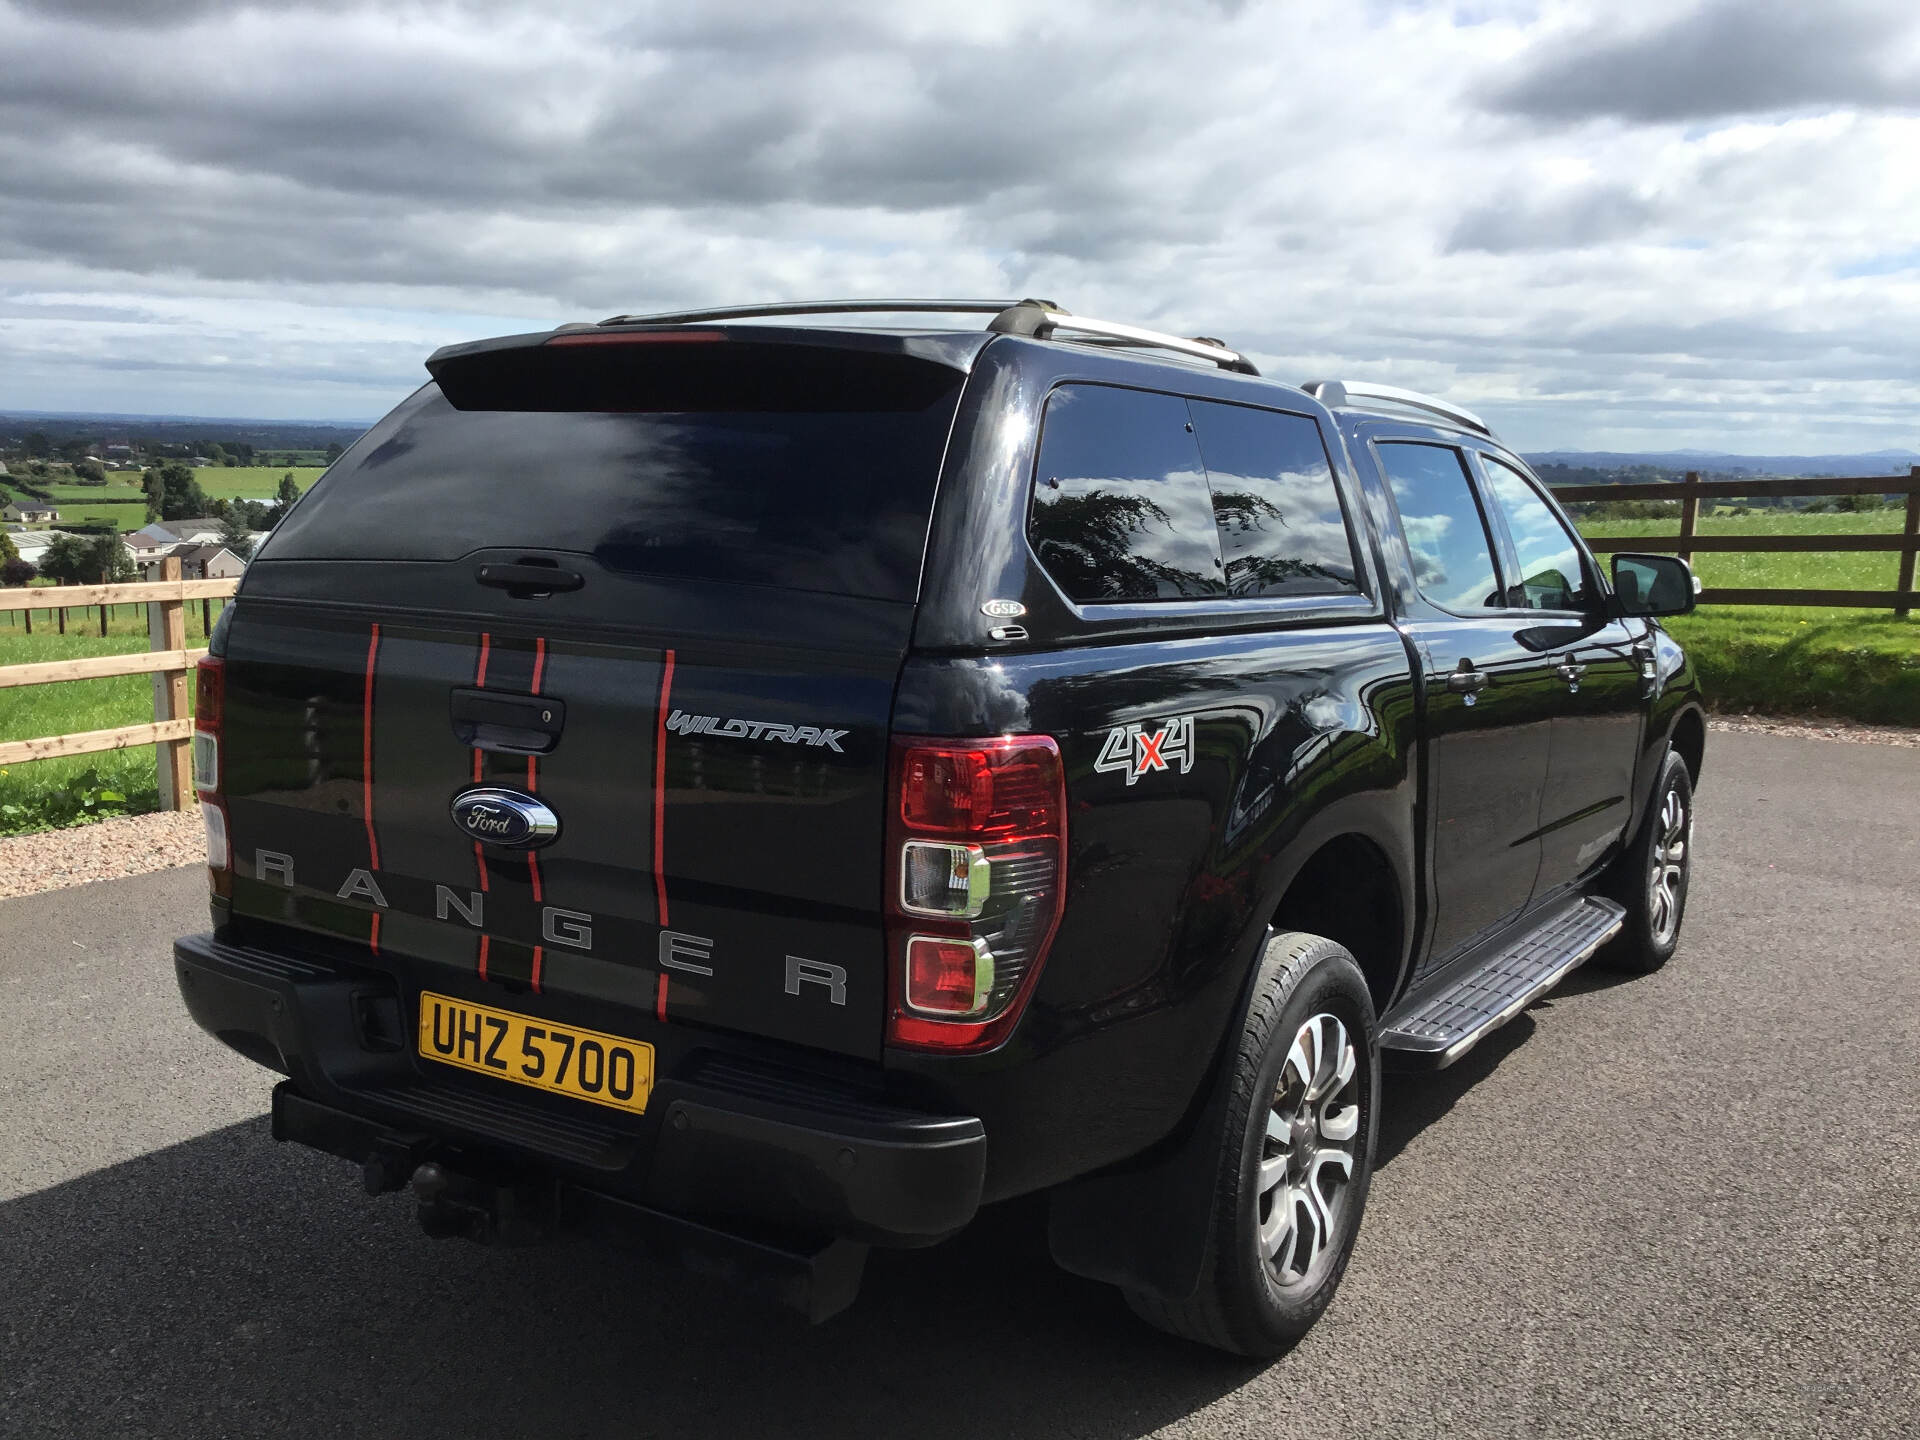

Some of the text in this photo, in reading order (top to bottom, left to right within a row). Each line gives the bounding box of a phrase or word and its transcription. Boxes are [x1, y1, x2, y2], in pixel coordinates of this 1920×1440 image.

[990, 603, 1019, 614] GSE
[666, 709, 850, 753] WILDTRAK
[467, 804, 511, 834] Ford
[255, 848, 848, 1006] RANGER
[432, 1003, 635, 1100] UHZ 5700
